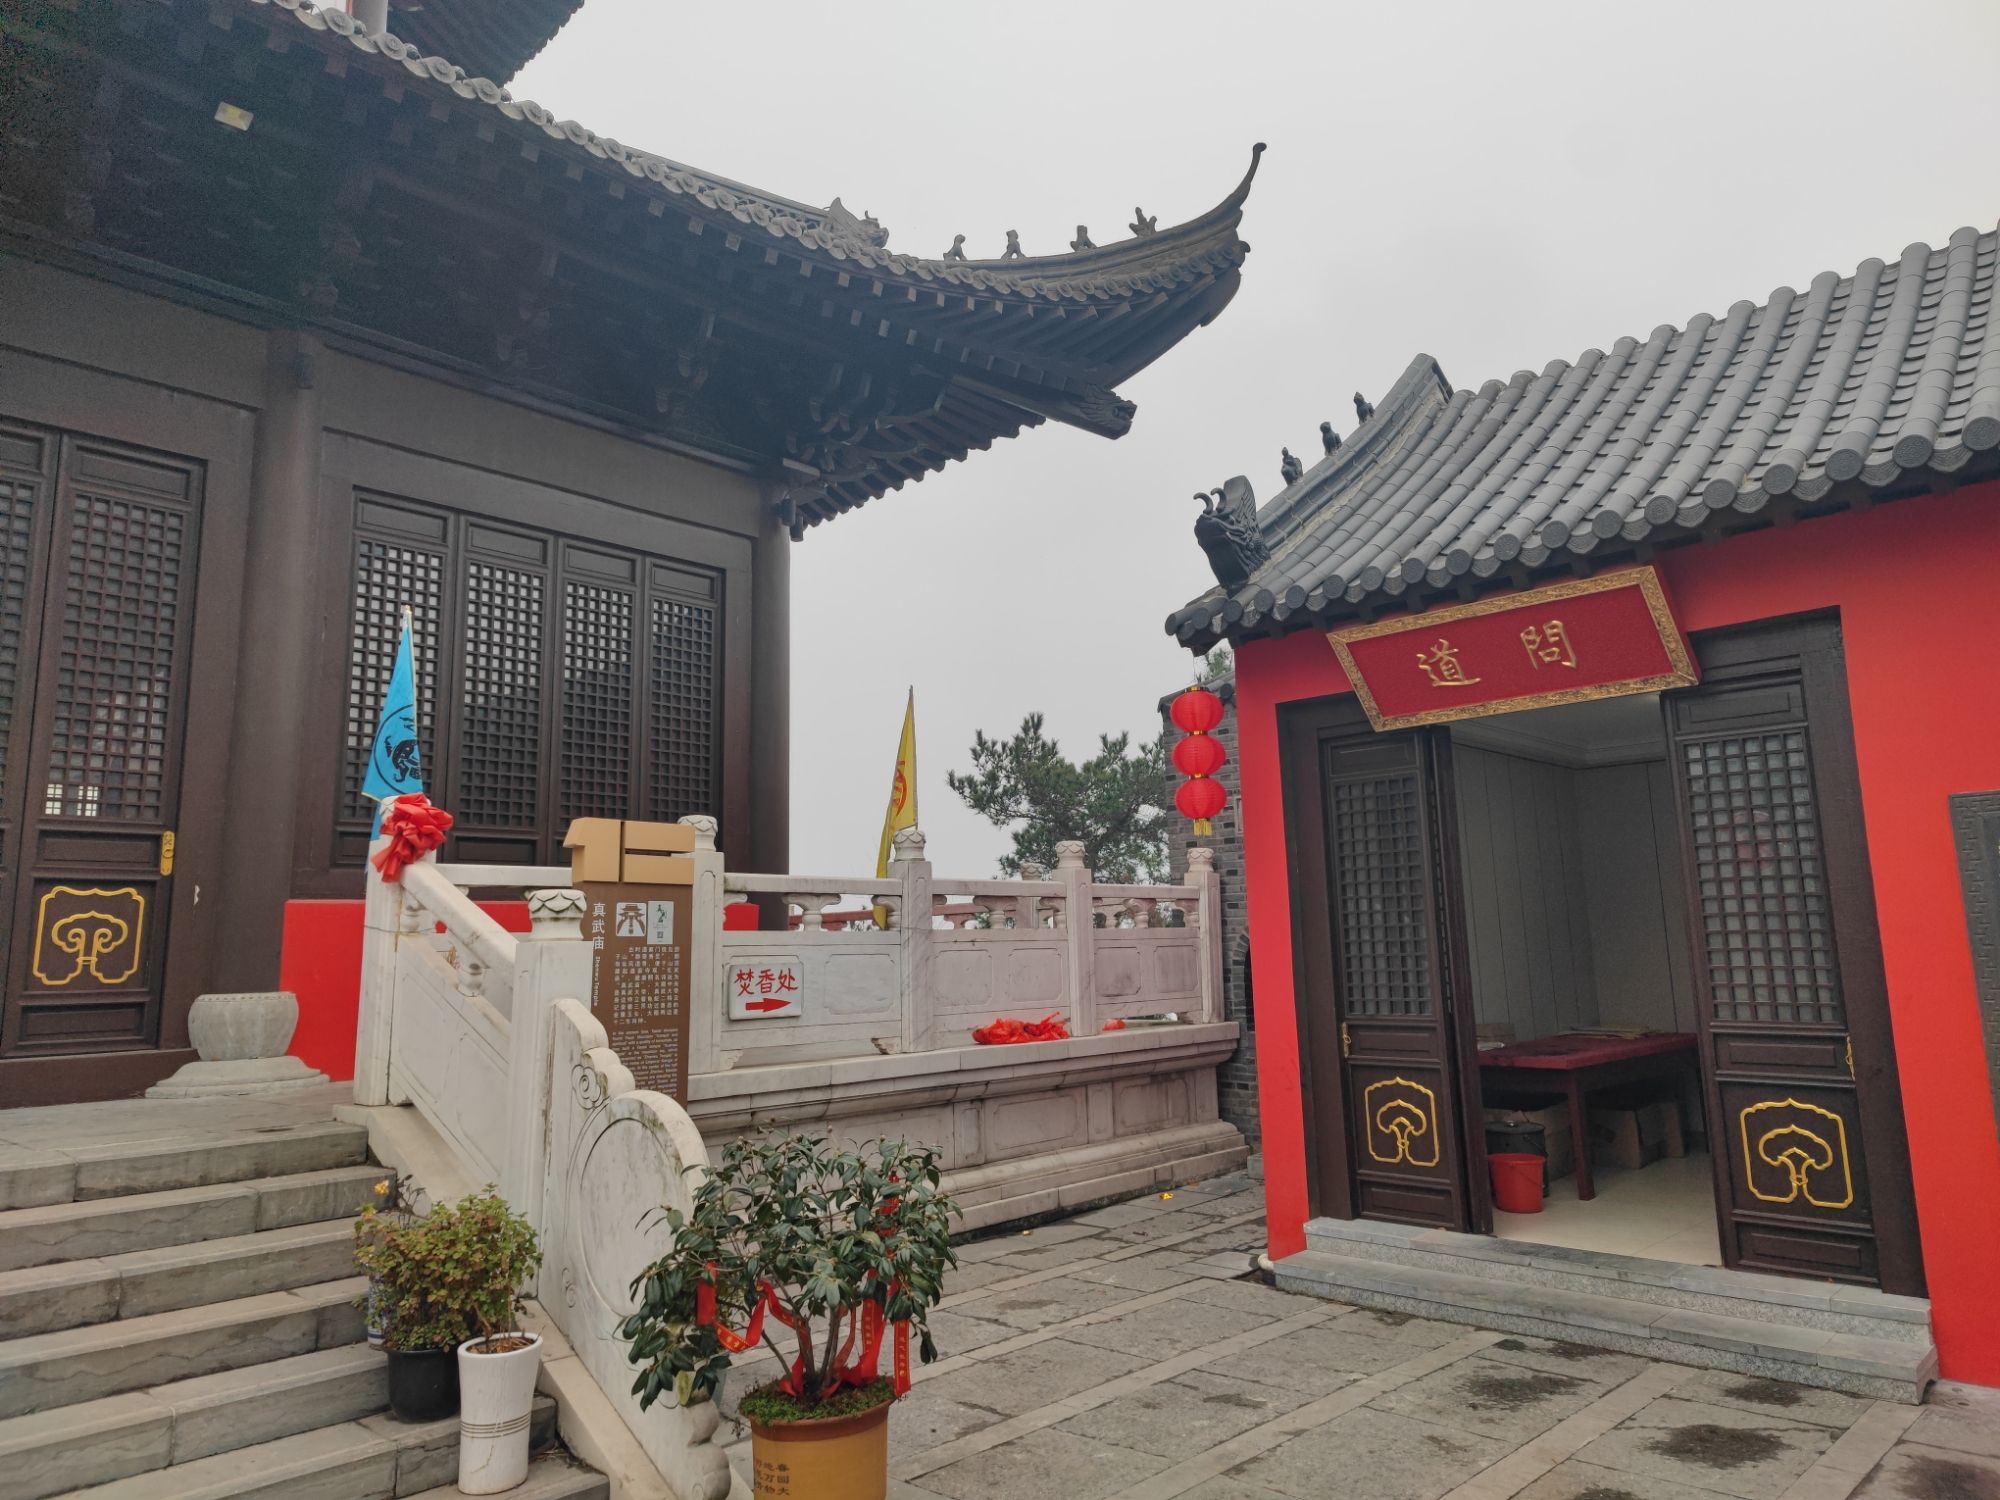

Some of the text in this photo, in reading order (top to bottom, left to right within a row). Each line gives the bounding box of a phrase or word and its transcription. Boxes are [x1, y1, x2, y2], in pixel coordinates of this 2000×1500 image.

[591, 902, 606, 951] 真武庙
[734, 967, 799, 997] 焚香处
